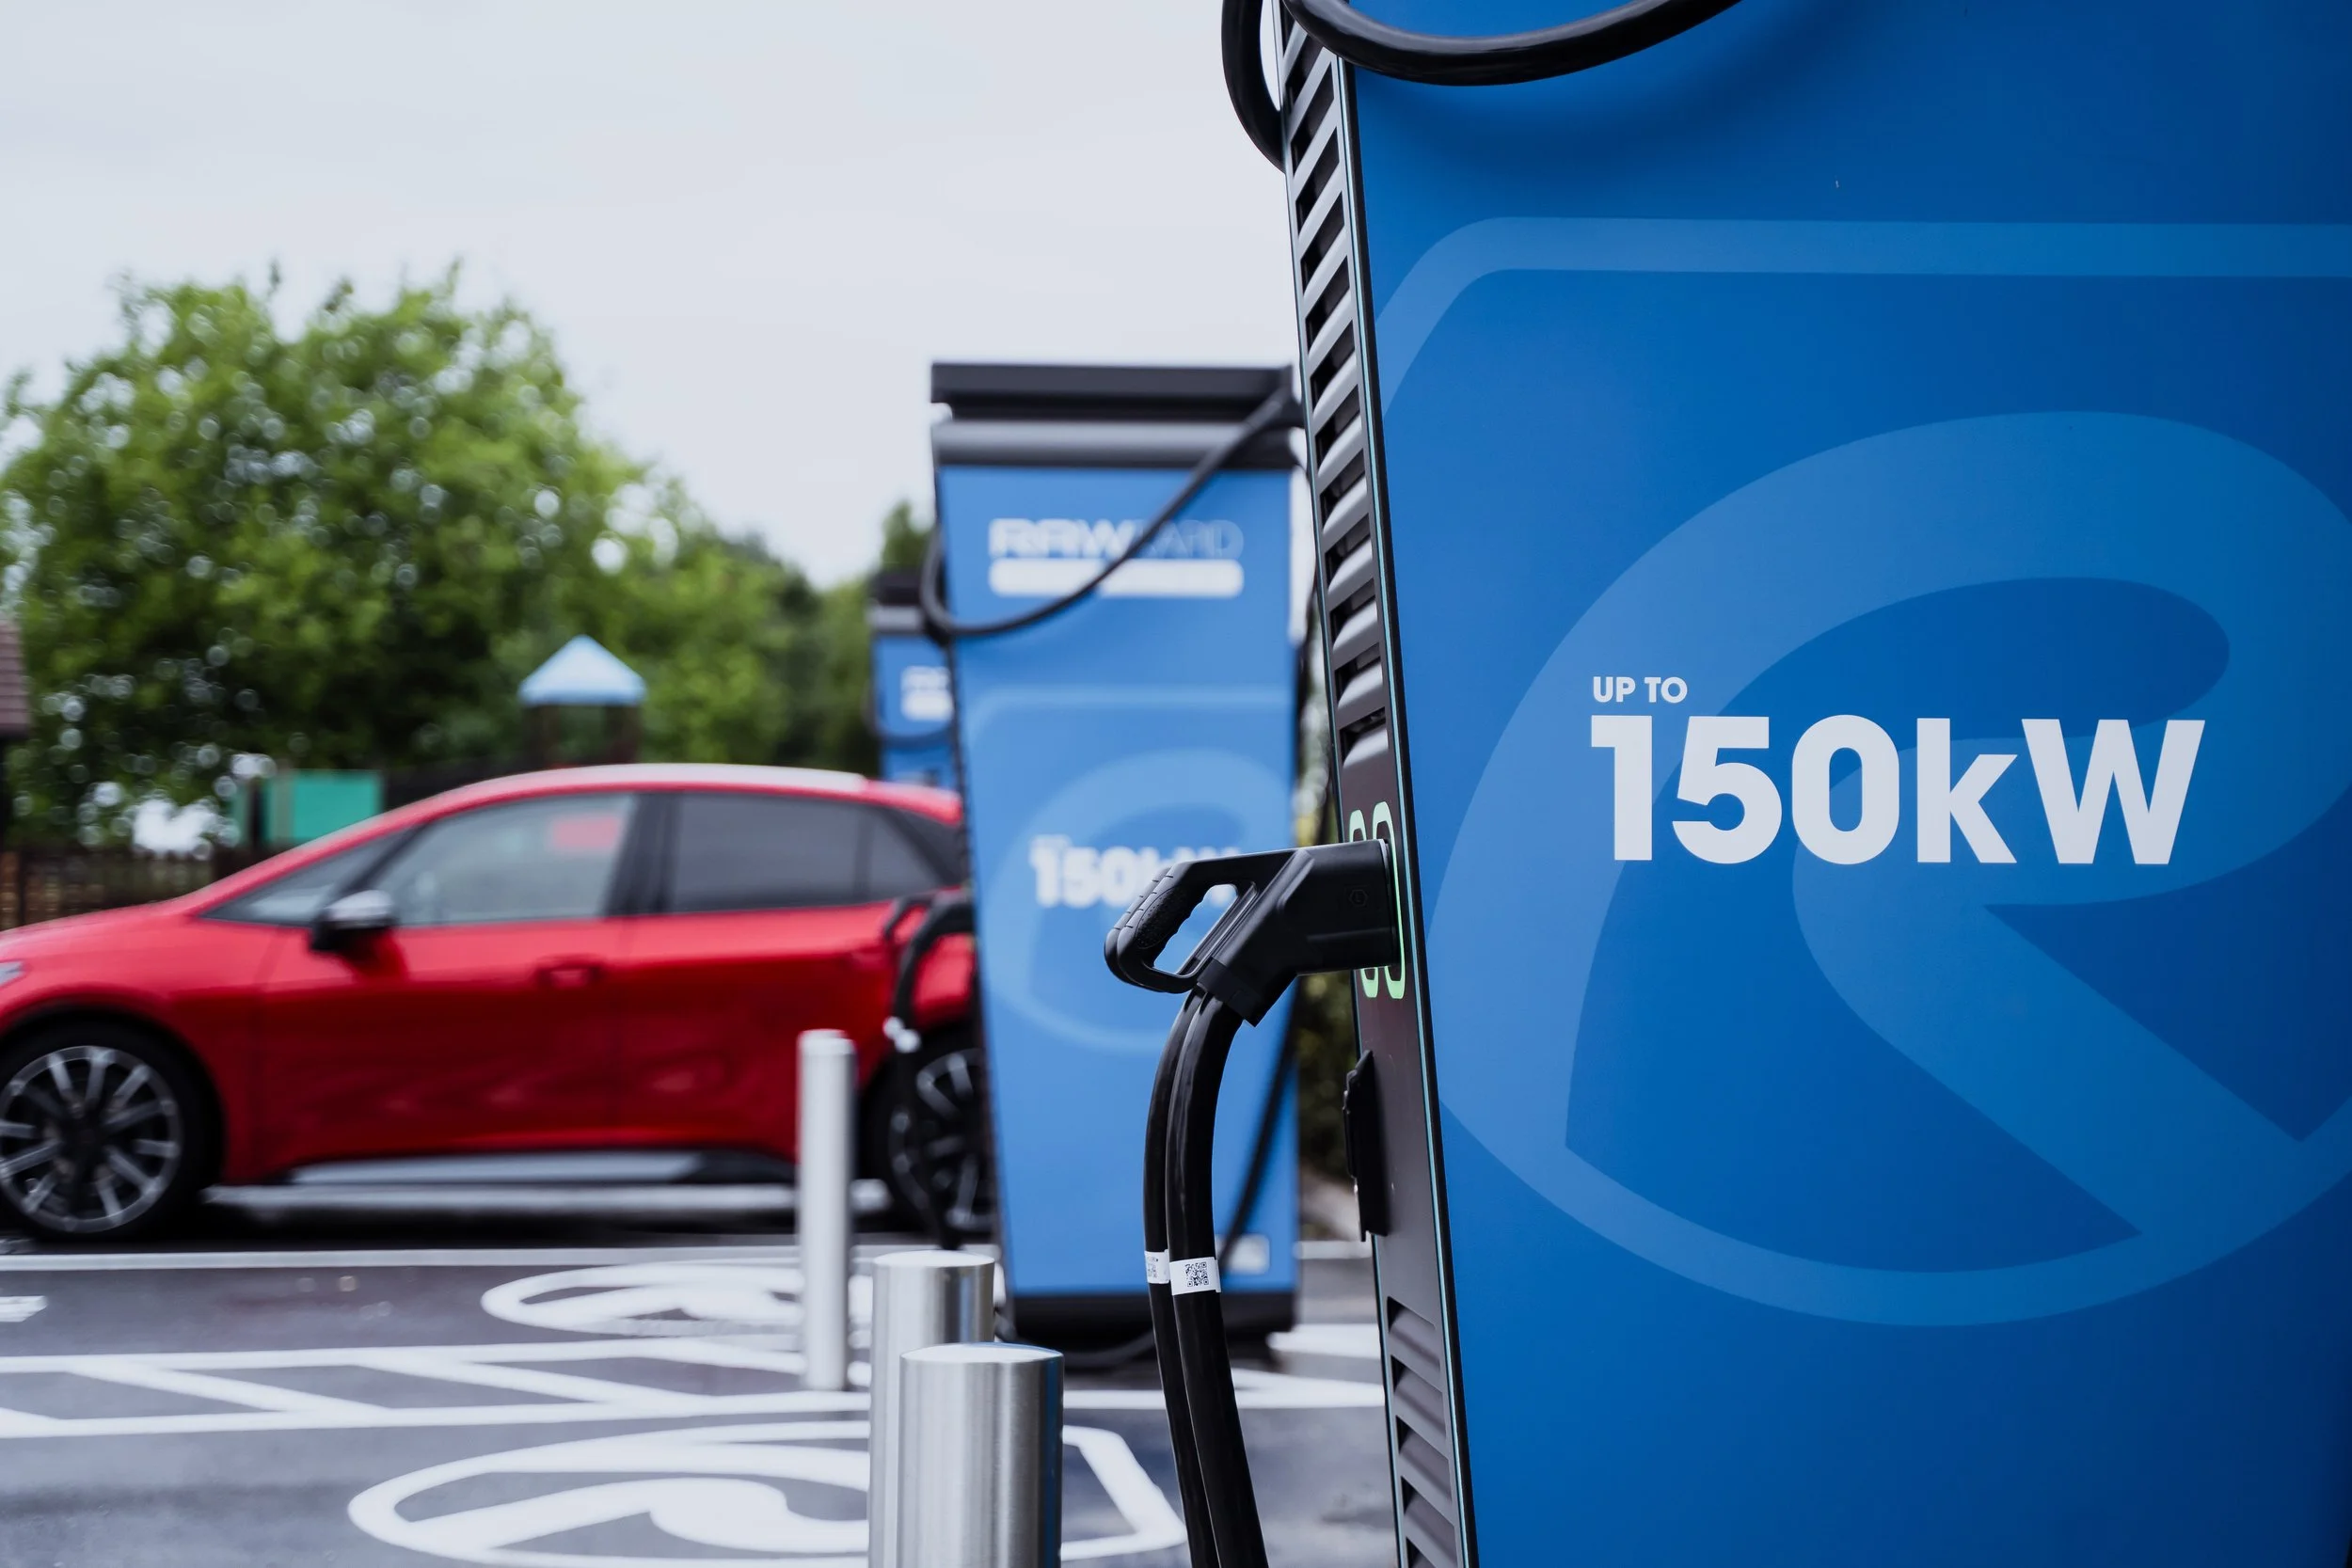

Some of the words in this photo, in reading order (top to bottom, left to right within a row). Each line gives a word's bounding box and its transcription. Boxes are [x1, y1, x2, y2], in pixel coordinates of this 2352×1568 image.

[1592, 675, 1636, 704] UP
[1644, 675, 1689, 704] TO
[1590, 714, 2206, 865] 150kW
